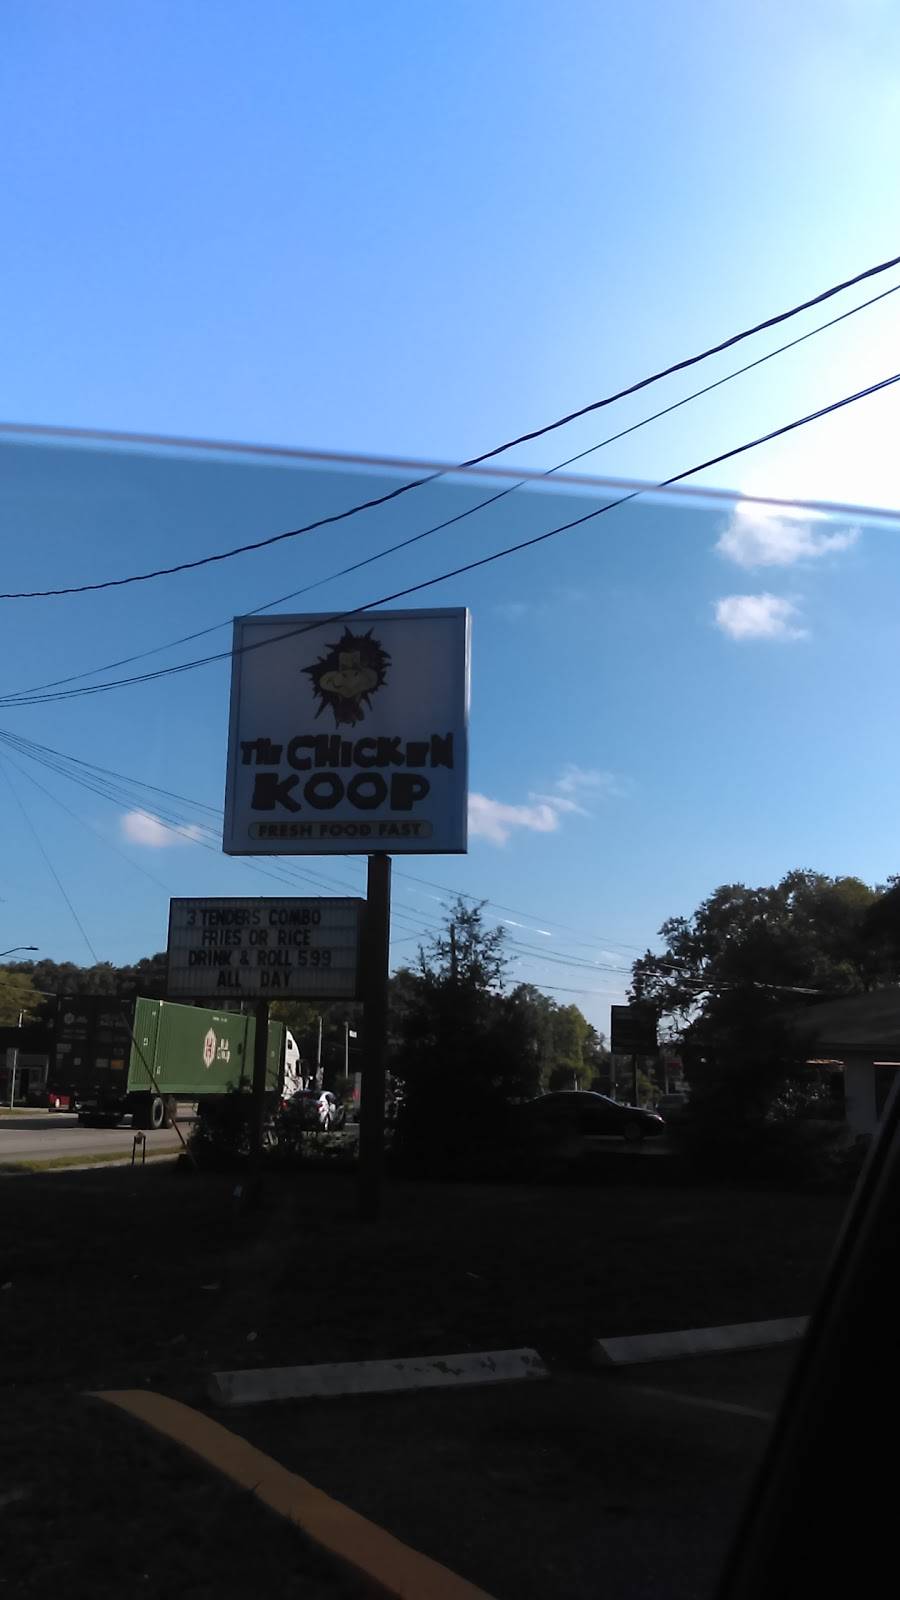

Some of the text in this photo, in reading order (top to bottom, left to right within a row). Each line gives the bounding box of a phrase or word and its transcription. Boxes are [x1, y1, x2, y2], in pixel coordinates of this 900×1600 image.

[240, 733, 455, 770] THE CHICKEN
[250, 772, 431, 813] KOOP
[257, 822, 423, 837] FRESH FOOD FAST
[187, 909, 322, 926] 3 TENDERS COMBO
[201, 929, 312, 946] FRIES OR RICE
[188, 950, 232, 966] DRINK
[239, 951, 250, 966] &
[257, 950, 293, 966] ROLL
[216, 970, 292, 987] ALL DAY
